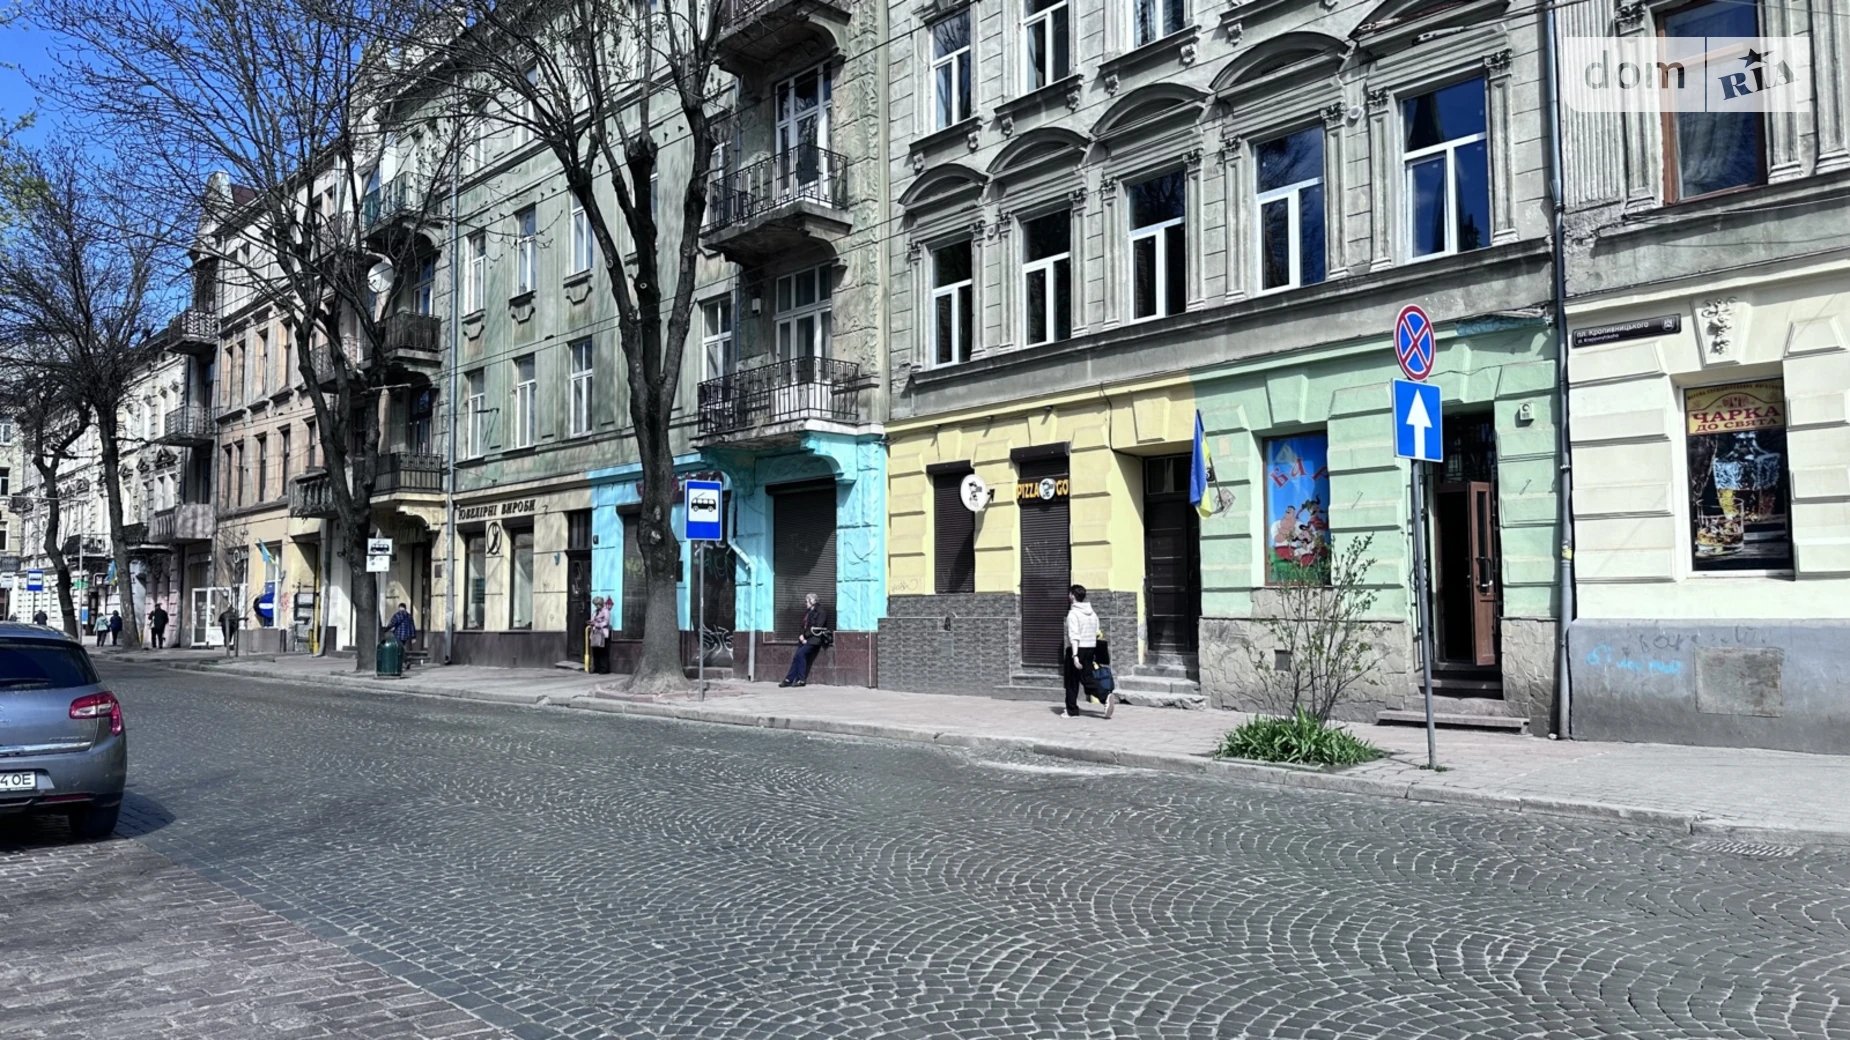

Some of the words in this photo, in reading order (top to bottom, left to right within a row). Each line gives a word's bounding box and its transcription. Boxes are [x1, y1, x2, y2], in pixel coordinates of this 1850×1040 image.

[1576, 330, 1587, 338] пл.
[1589, 321, 1649, 337] Кропивницького
[1691, 405, 1781, 424] ЧАРКА
[1695, 422, 1719, 432] ДО
[1724, 417, 1778, 429] СВЯТА
[1016, 481, 1040, 499] PIZZA
[1056, 479, 1069, 496] GO
[458, 504, 498, 521] ЮВЕЛІРНІ
[501, 498, 537, 515] ВИРОБИ
[11, 773, 32, 786] OE
